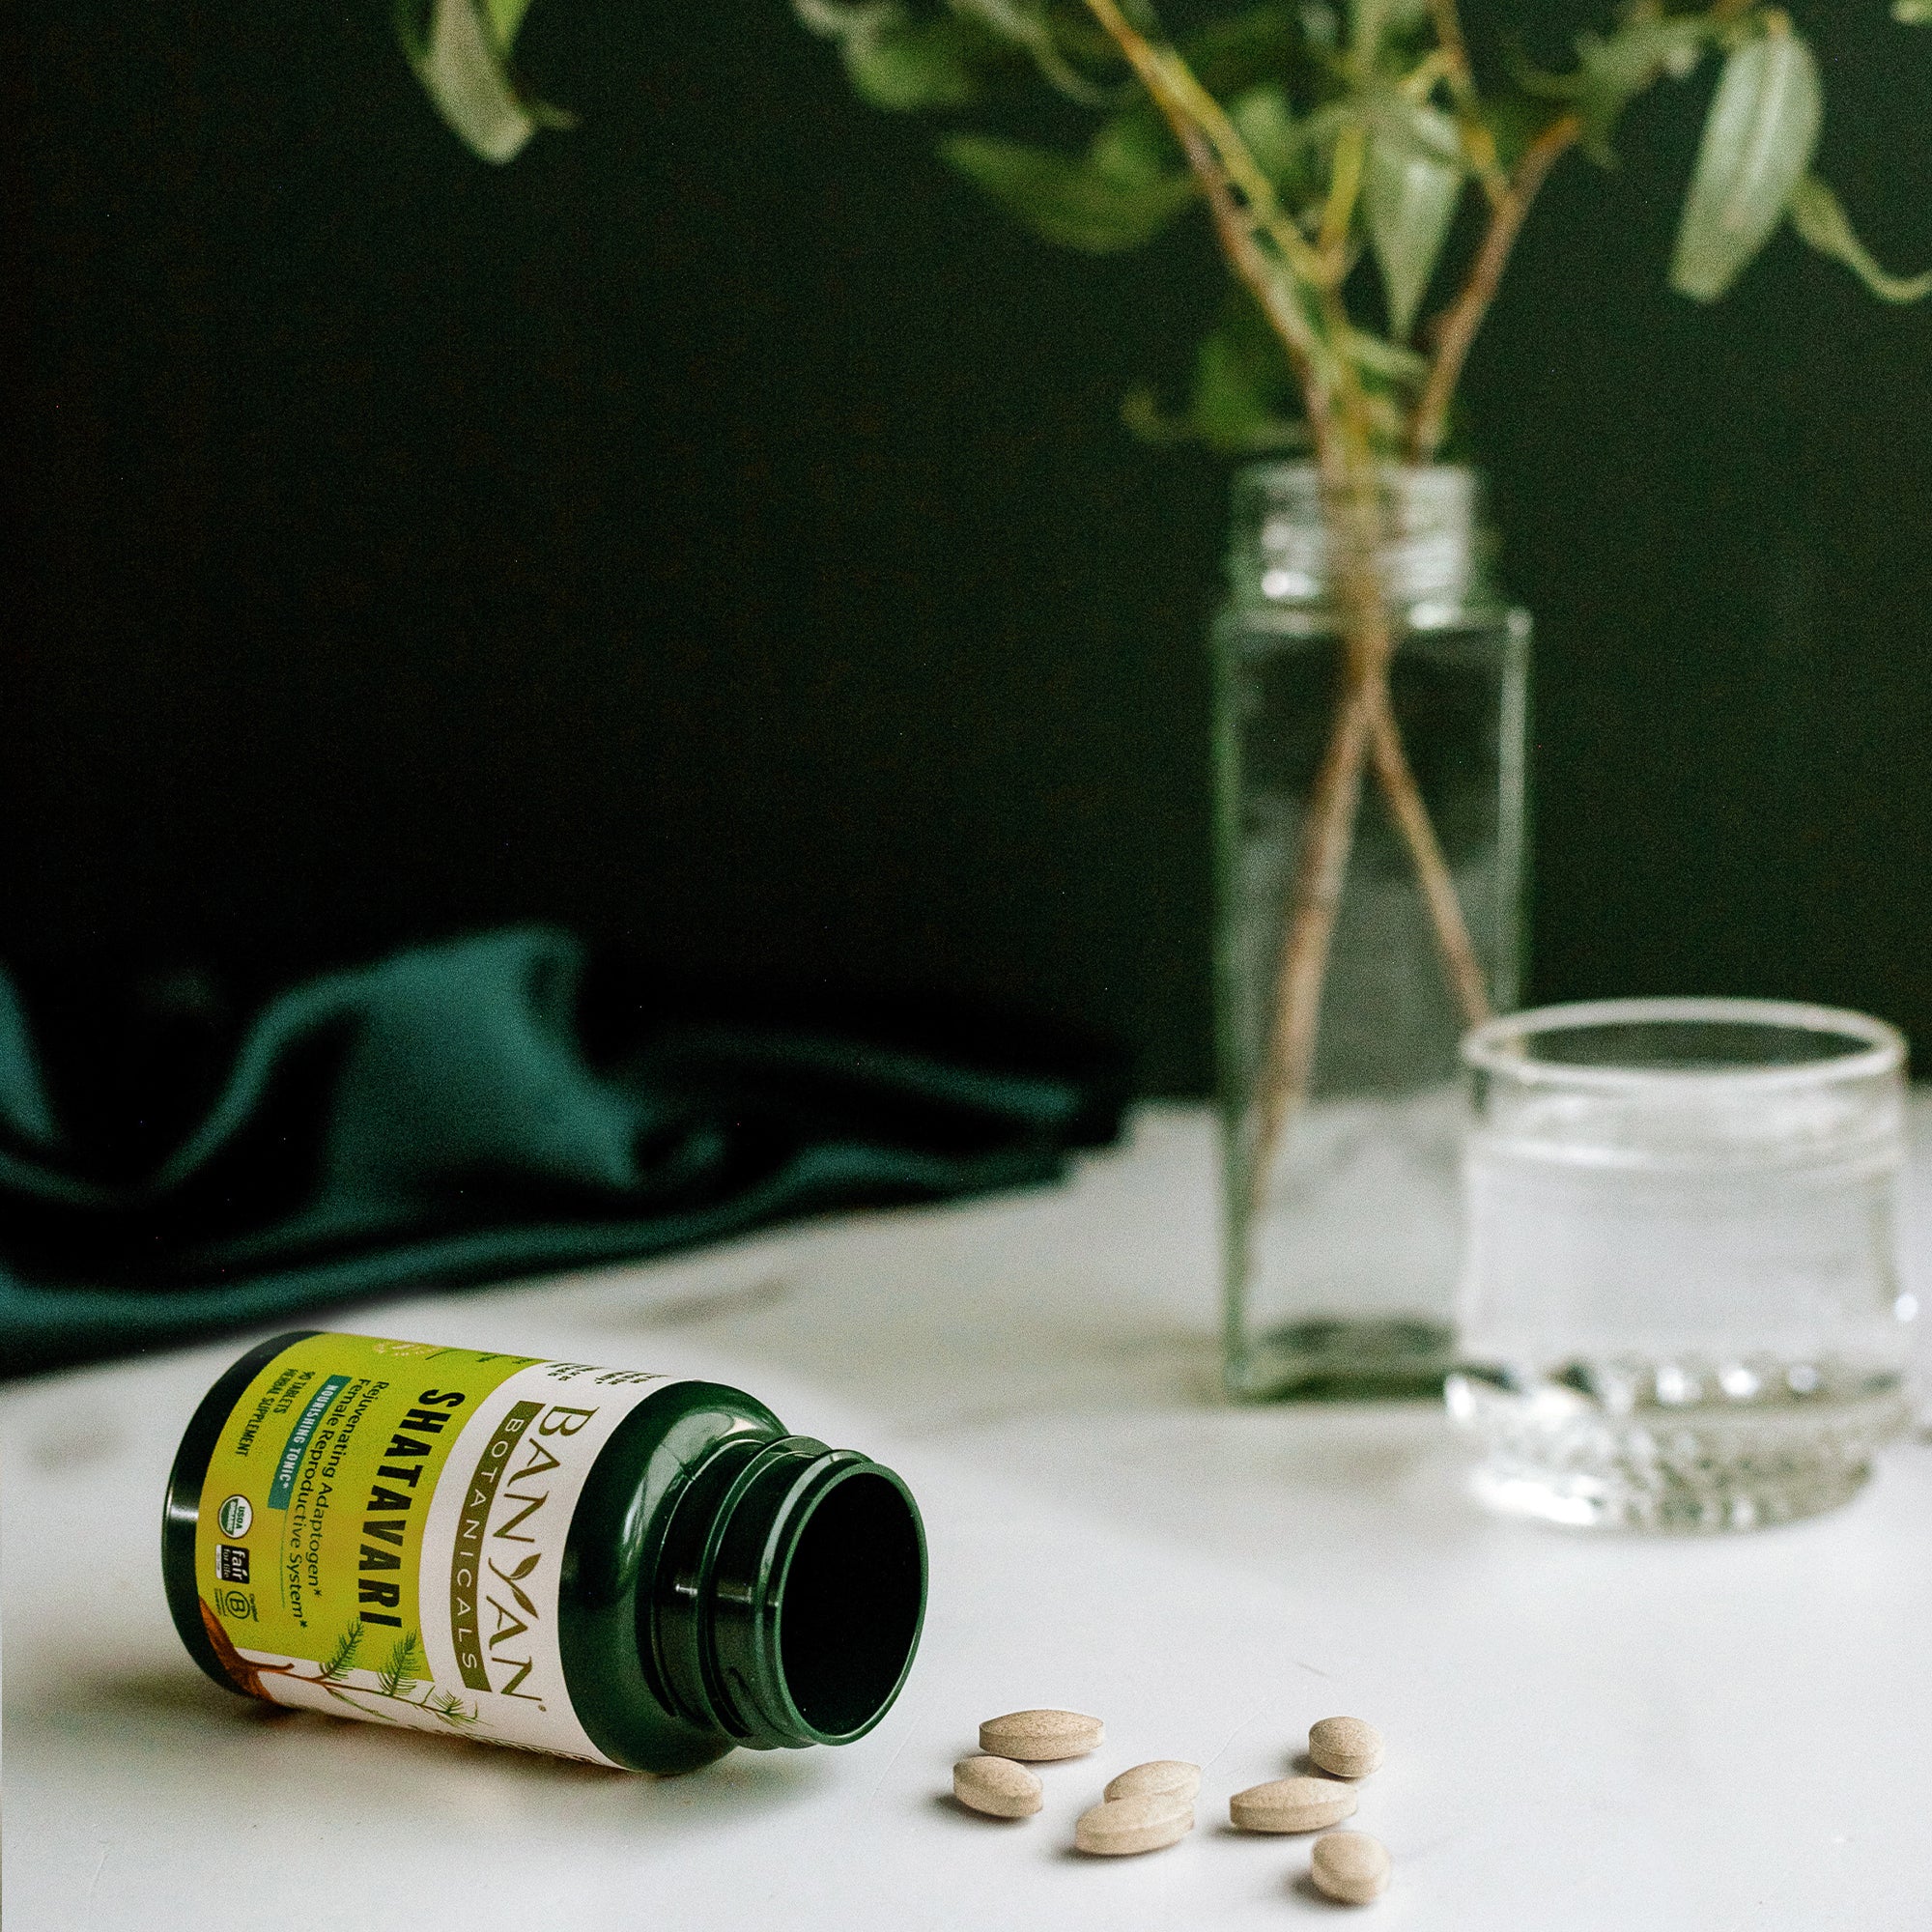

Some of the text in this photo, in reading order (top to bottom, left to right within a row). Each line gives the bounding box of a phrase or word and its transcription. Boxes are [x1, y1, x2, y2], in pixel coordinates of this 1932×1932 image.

[235, 1397, 275, 1457] SUPPLEMENT
[272, 1381, 306, 1414] TABLETS
[293, 1384, 339, 1444] NOURISHING
[327, 1378, 371, 1427] Female
[322, 1380, 389, 1478] Rejuvenating
[236, 1506, 245, 1529] USDA
[290, 1429, 334, 1548] Reproductive
[357, 1388, 466, 1629] SHATAVARI
[222, 1548, 232, 1578] for life
[232, 1549, 247, 1580] fair
[456, 1417, 523, 1670] BOTANICALS
[486, 1406, 600, 1702] BANYAN
